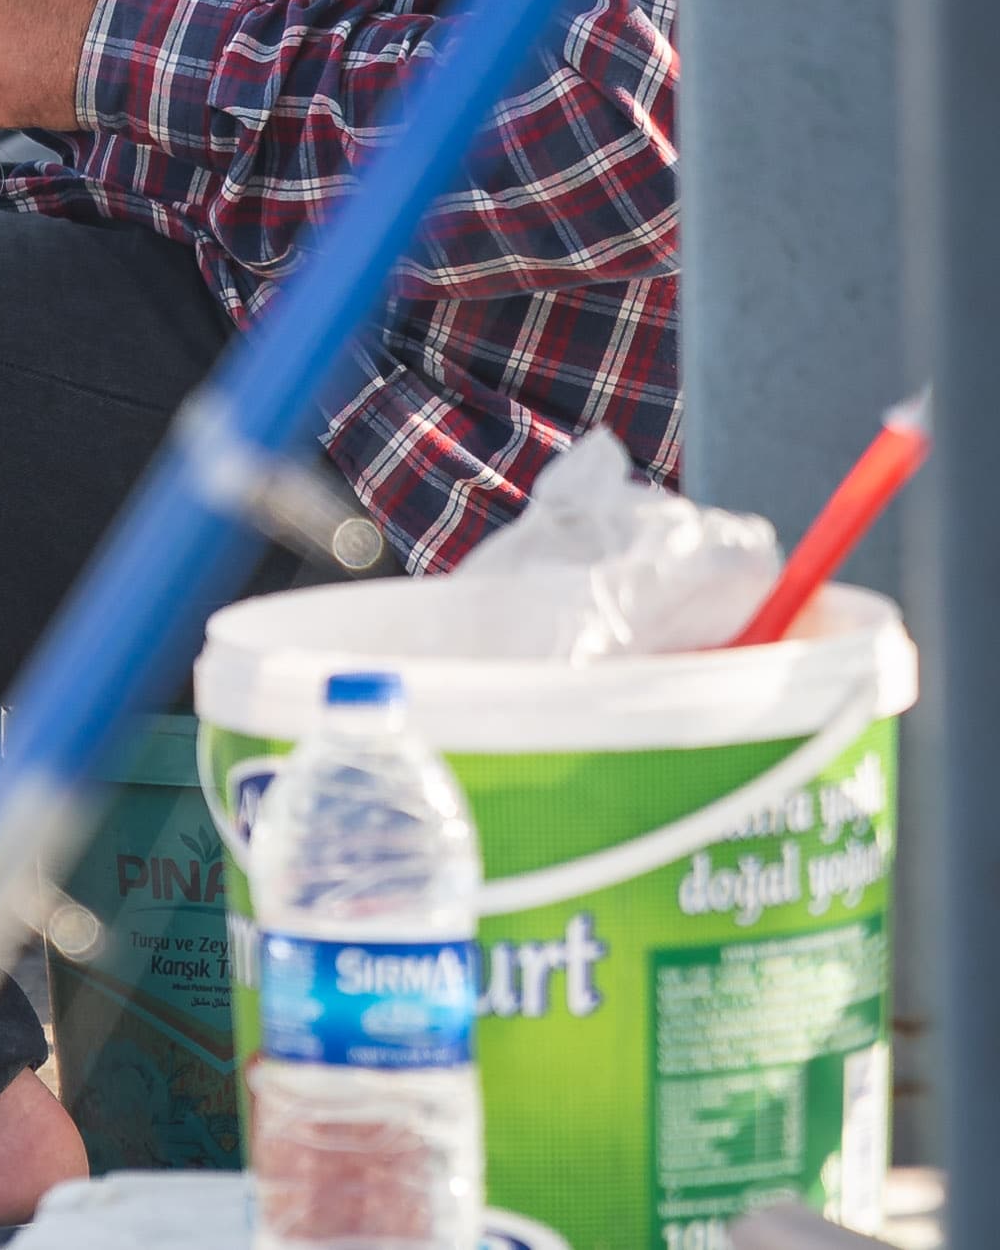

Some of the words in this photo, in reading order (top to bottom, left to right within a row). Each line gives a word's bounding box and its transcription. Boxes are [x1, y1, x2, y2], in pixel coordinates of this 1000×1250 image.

[116, 853, 228, 903] PINA
[678, 840, 801, 927] doğal
[131, 931, 169, 953] Turşu
[175, 939, 193, 951] ve
[199, 937, 229, 958] Zey
[477, 911, 608, 1019] urt
